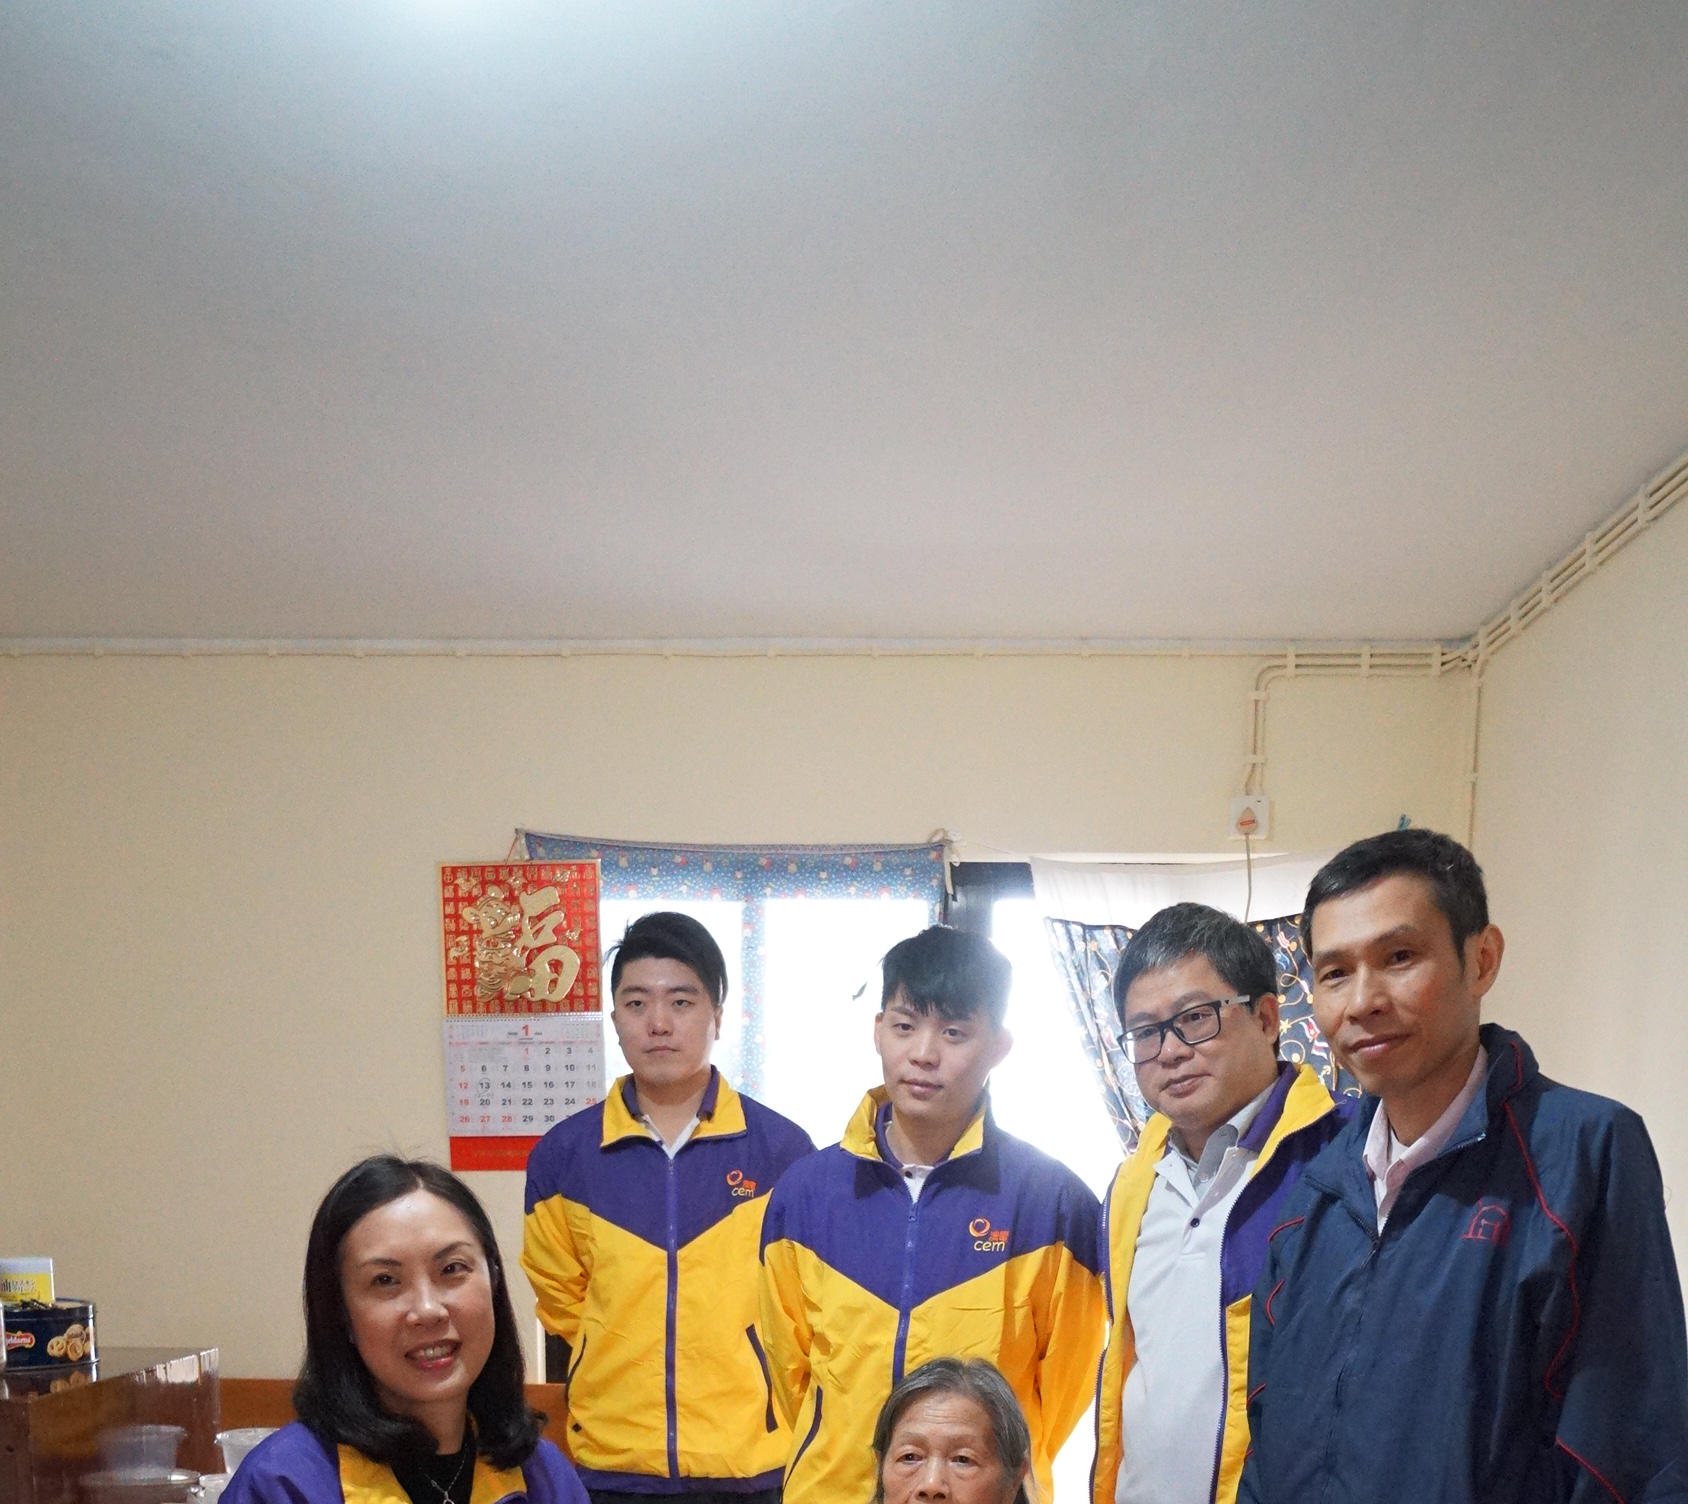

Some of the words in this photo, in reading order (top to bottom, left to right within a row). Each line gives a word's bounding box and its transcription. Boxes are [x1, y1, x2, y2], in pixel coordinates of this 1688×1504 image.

[521, 1024, 530, 1037] 1
[564, 1063, 576, 1072] 10
[458, 1082, 469, 1090] 12
[479, 1081, 491, 1090] 13
[500, 1081, 512, 1089] 14
[521, 1081, 533, 1089] 15
[543, 1081, 555, 1089] 16
[564, 1080, 576, 1089] 17
[458, 1098, 470, 1106] 19
[479, 1098, 491, 1106] 20
[501, 1098, 512, 1106] 21
[522, 1098, 533, 1106] 22
[543, 1098, 555, 1106] 23
[564, 1097, 576, 1106] 24
[585, 1097, 599, 1107] 25
[459, 1115, 470, 1123] 26
[480, 1115, 491, 1123] 27
[501, 1115, 513, 1123] 28
[522, 1115, 534, 1123] 29
[544, 1114, 555, 1123] 30
[731, 1187, 754, 1198] cem
[974, 1240, 1006, 1252] cem
